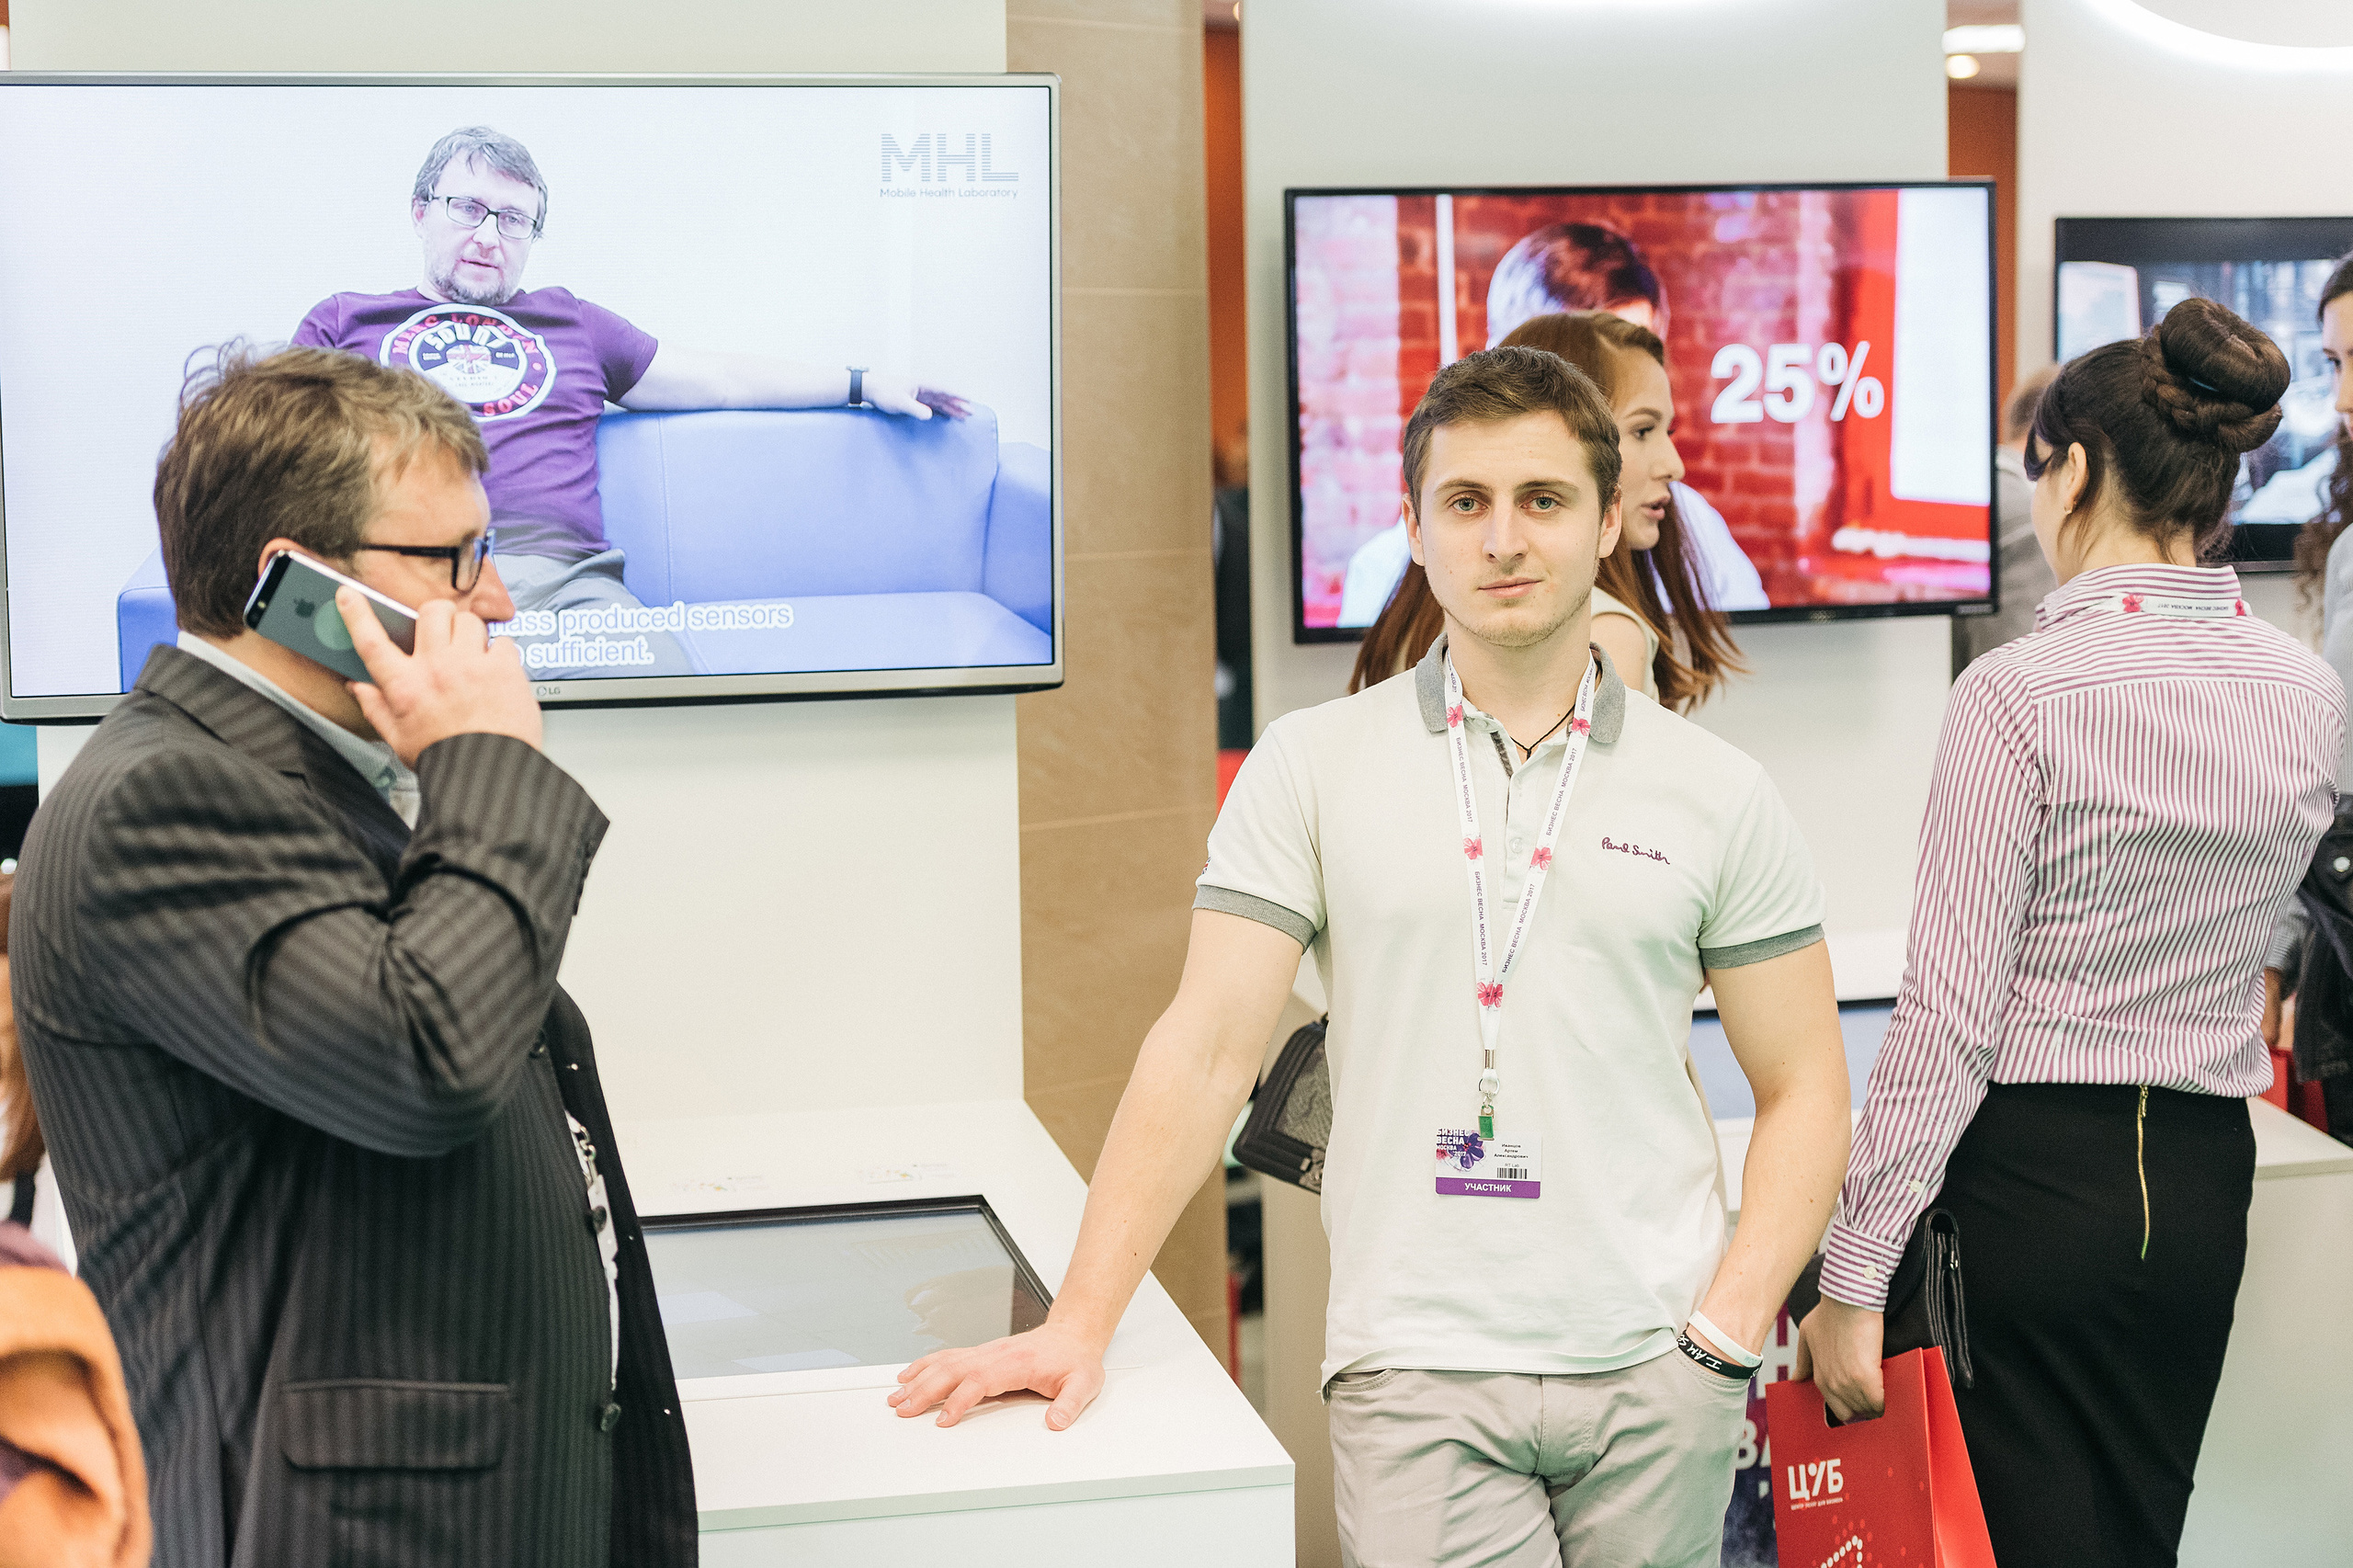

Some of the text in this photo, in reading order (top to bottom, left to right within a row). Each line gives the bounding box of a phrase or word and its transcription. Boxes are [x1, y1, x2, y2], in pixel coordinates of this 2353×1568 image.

[881, 132, 1019, 182] MHL
[879, 187, 1018, 199] Mobile Health Laboratory
[1710, 340, 1884, 425] 25%
[483, 382, 539, 416] SOUL
[562, 603, 684, 635] produced
[690, 607, 790, 628] sensors
[529, 637, 654, 664] sufficient.
[548, 687, 561, 696] LG
[1546, 748, 1577, 836] БИЗНЕС ВЕСНА МОСКВА 2017
[1601, 836, 1671, 865] Paul Smith
[1474, 870, 1483, 897] БИЗНЕС
[1502, 883, 1536, 973] БИЗНЕС ВЕСНА МОСКВА 2017
[1436, 1136, 1465, 1145] ВЕСНА
[1464, 1182, 1512, 1193] УЧАСТНИК
[1687, 1344, 1708, 1360] AM
